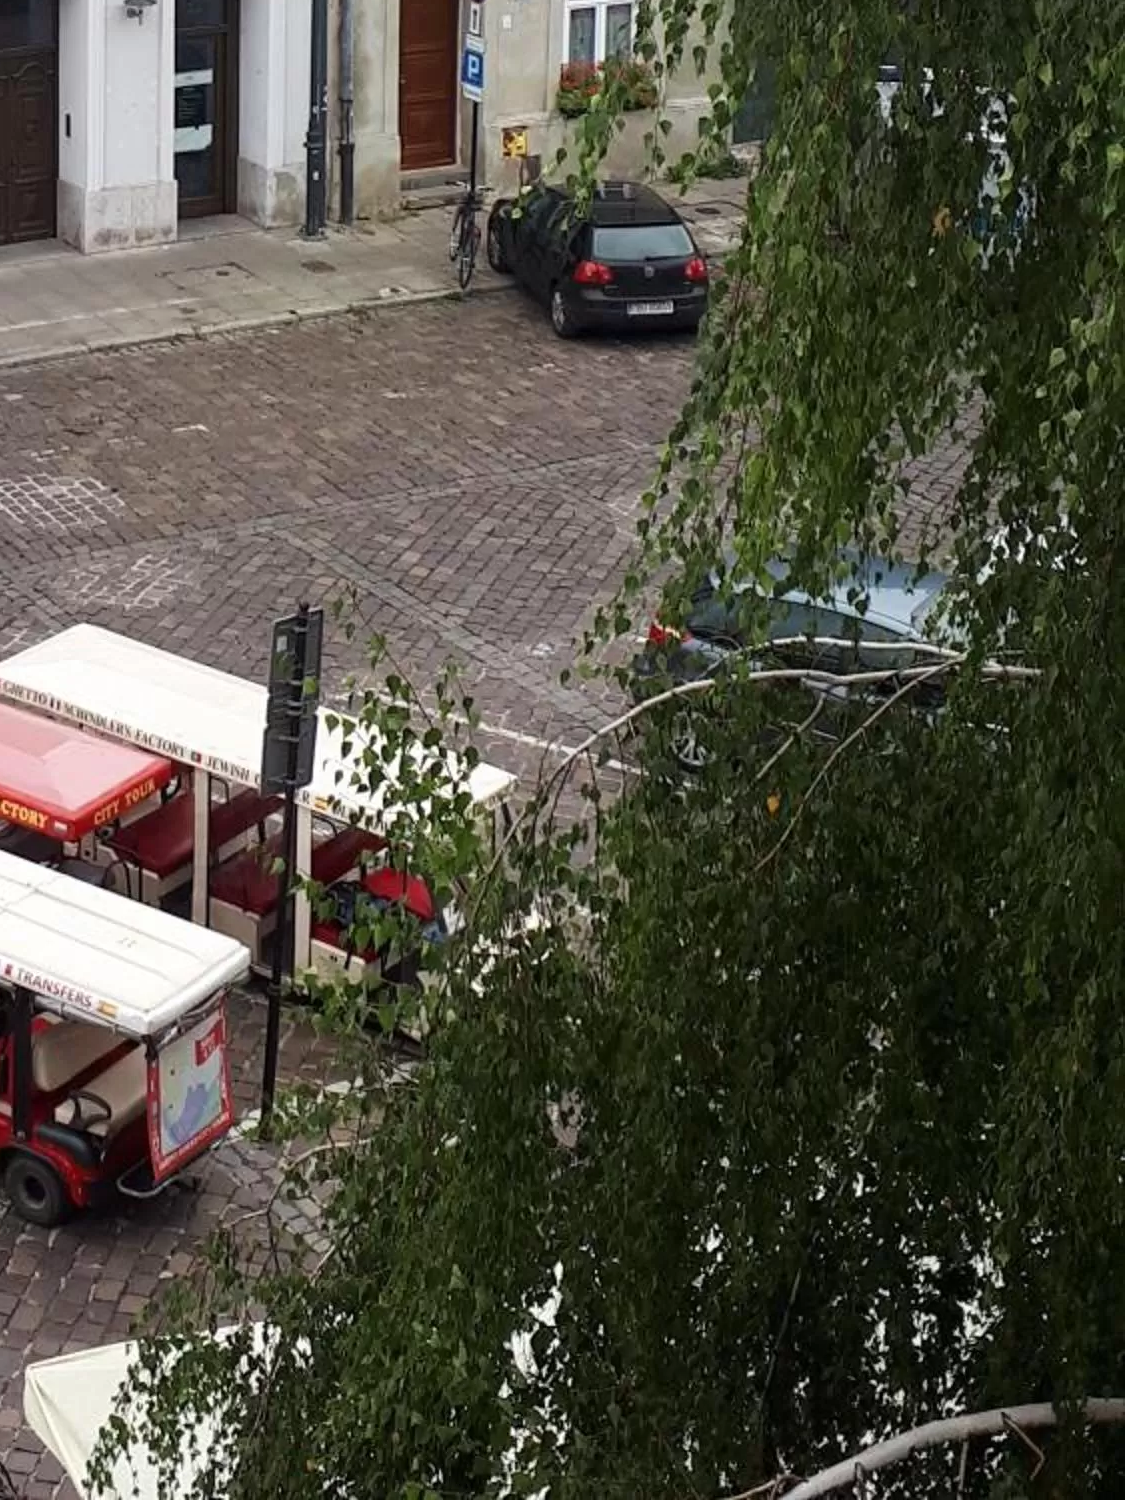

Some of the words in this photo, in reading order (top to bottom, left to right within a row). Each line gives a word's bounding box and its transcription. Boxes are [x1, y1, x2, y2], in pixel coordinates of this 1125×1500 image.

[468, 53, 480, 79] P
[3, 680, 47, 705] GHETTO
[133, 727, 187, 758] FACTORY
[206, 751, 250, 782] JEWISH
[94, 802, 120, 826] CITY
[125, 779, 156, 805] TOUR
[17, 967, 93, 1007] TRANSFERS
